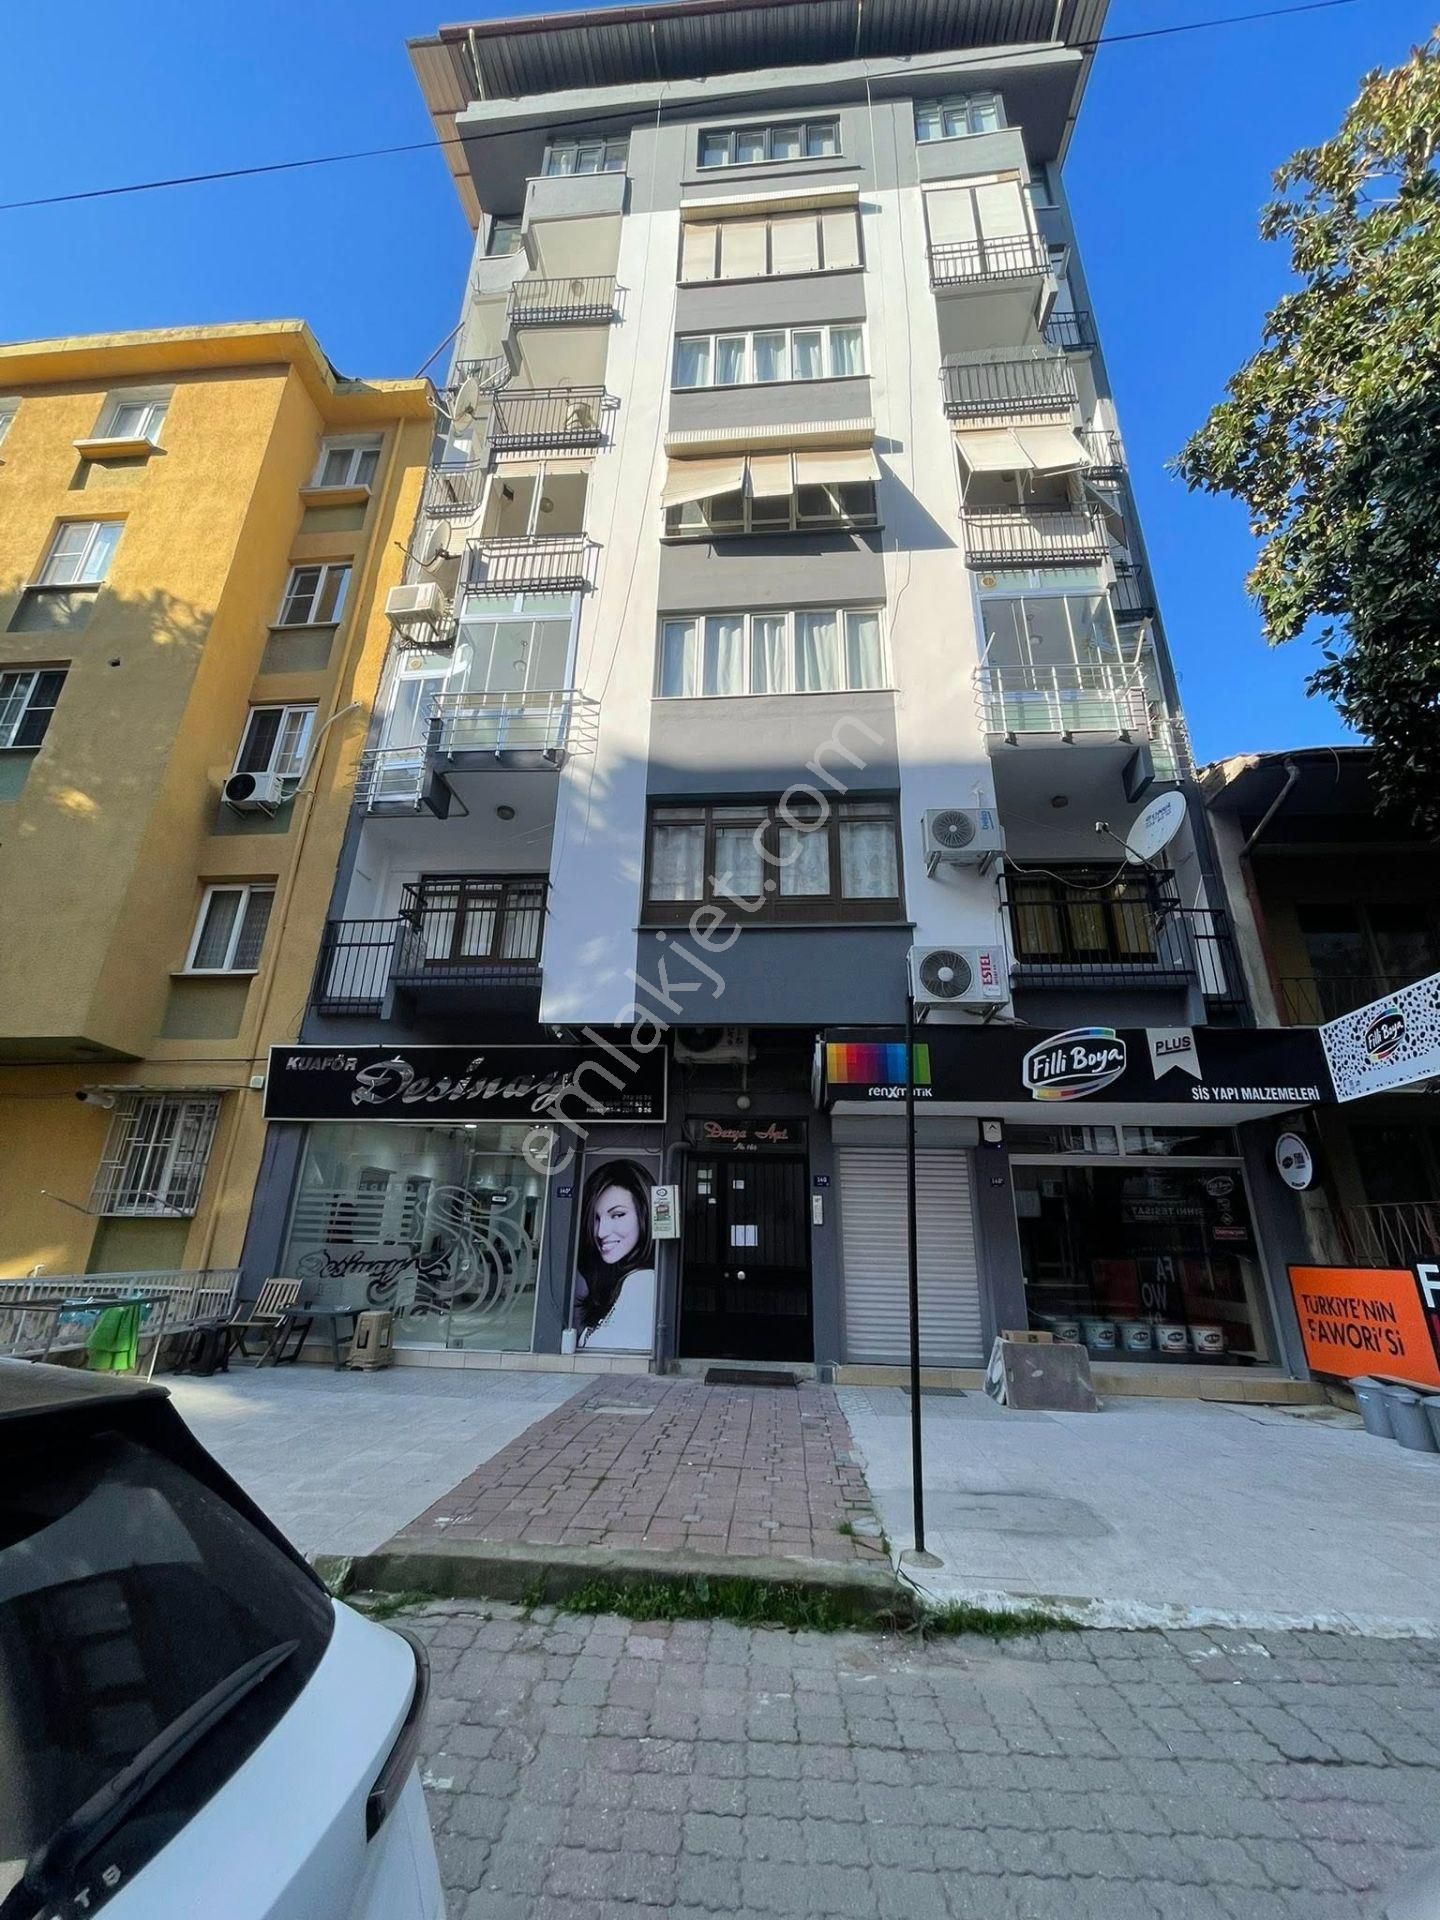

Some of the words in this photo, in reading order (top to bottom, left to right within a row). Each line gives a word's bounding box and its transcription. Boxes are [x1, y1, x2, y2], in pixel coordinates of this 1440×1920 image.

[980, 953, 993, 985] ESTEL
[1381, 1020, 1404, 1040] Boya
[1155, 1036, 1192, 1052] PLUS
[285, 1054, 358, 1071] KUAFÖR
[1032, 1056, 1066, 1080] Filli
[1072, 1046, 1124, 1073] Boya
[1191, 1085, 1210, 1101] SİS
[1211, 1086, 1240, 1100] YAPI
[1240, 1085, 1320, 1101] MALZEMELERİ
[1306, 1318, 1405, 1356] FAWORİ'Sİ
